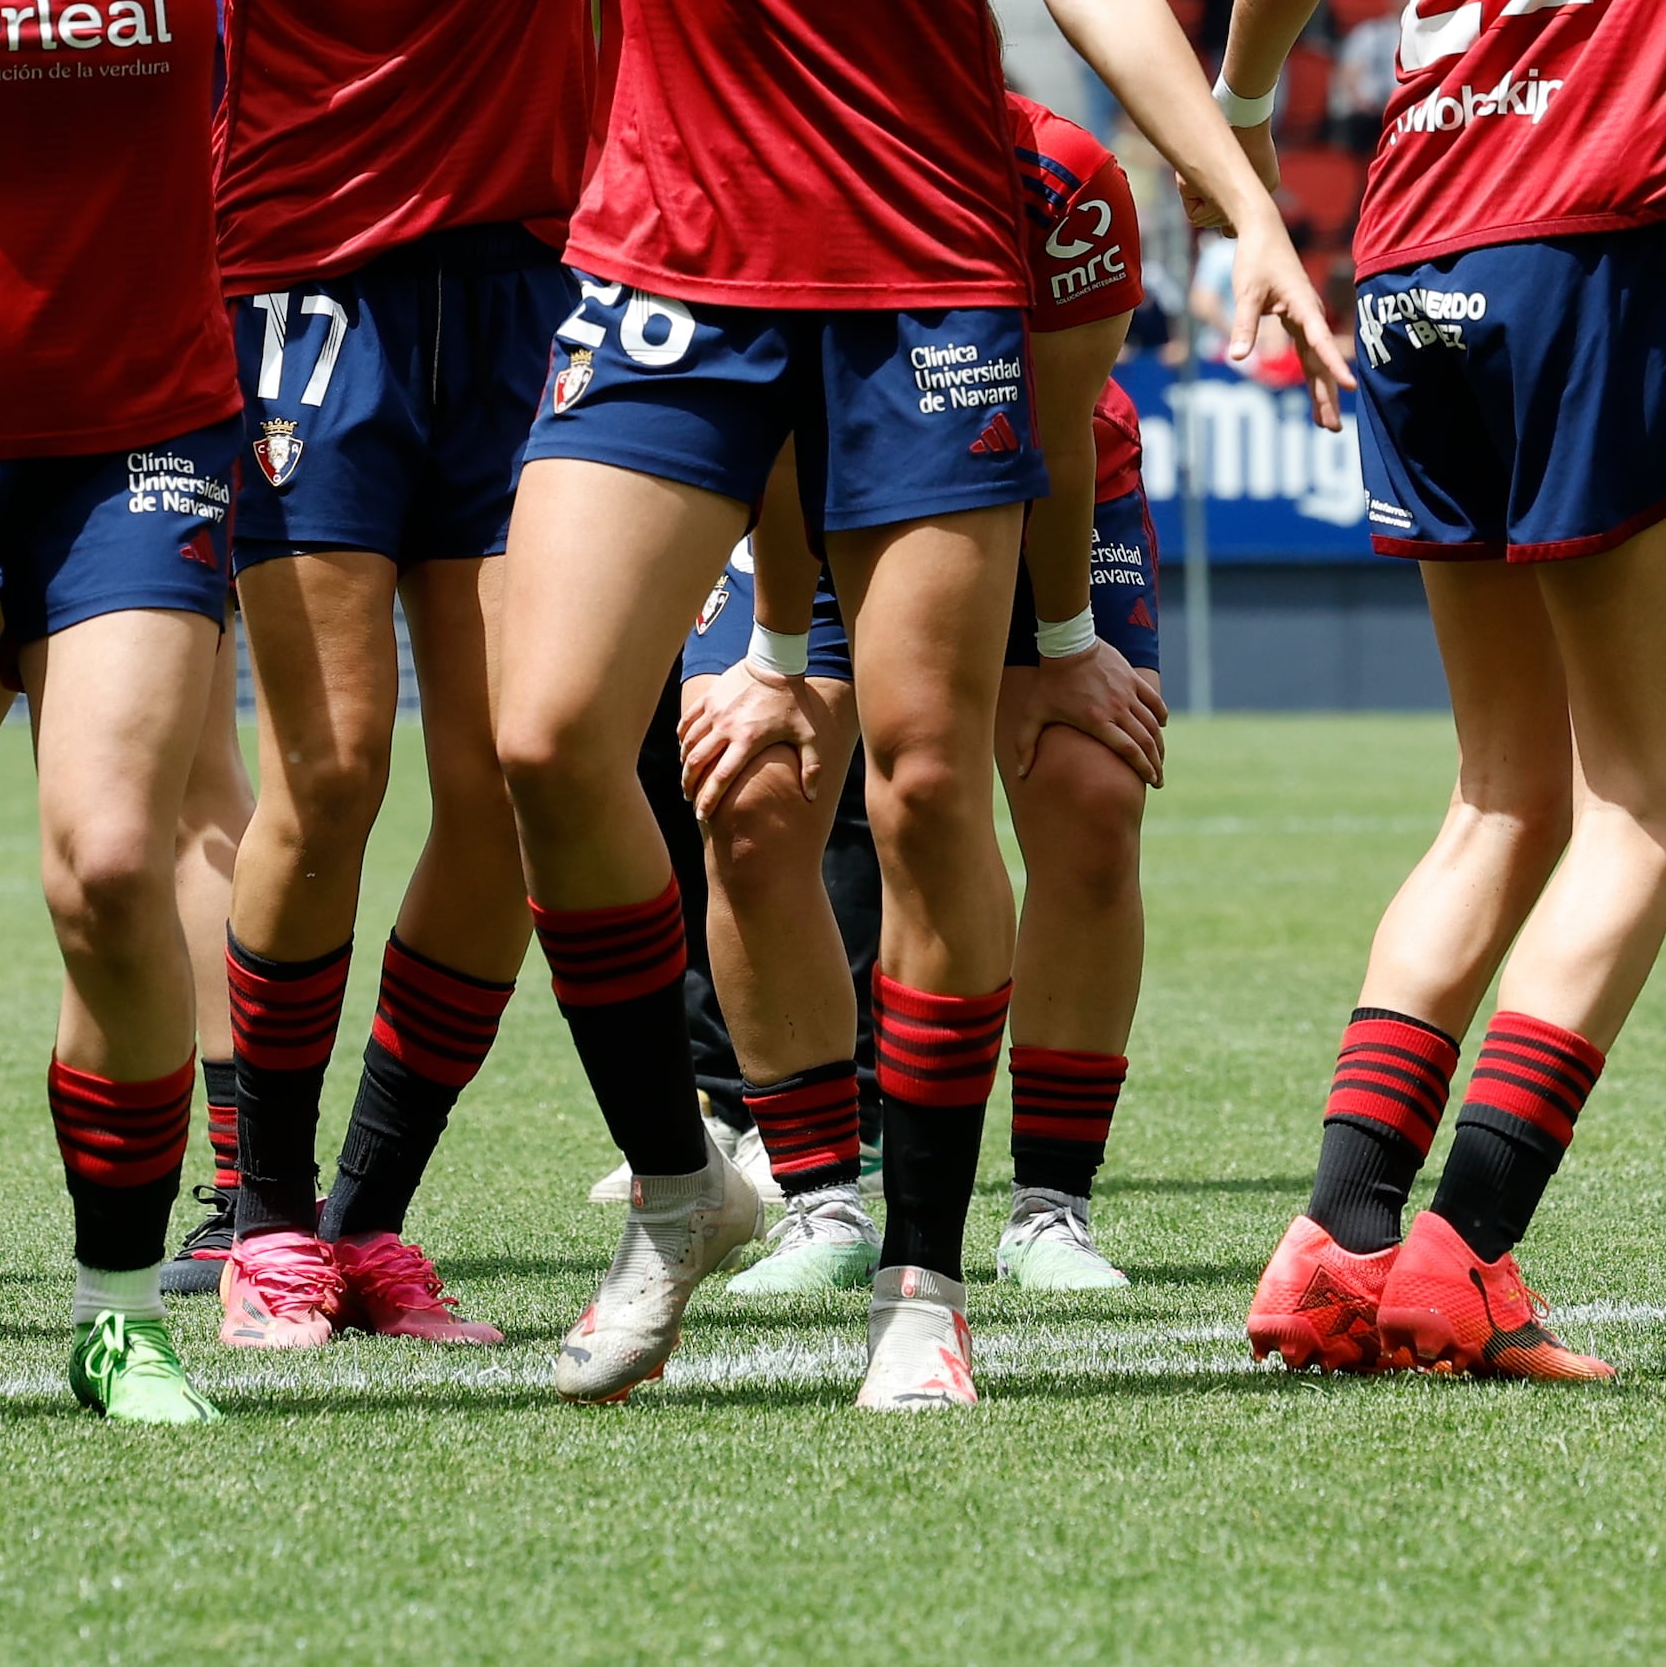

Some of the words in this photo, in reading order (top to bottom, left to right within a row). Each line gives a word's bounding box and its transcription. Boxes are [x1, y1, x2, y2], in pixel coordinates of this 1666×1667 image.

[48, 61, 72, 79] de
[77, 61, 93, 78] la
[99, 59, 171, 76] verdura
[1050, 244, 1125, 299] mrc
[1055, 286, 1092, 306] SOLUCIONES
[252, 292, 349, 407] 17
[911, 343, 978, 369] Clínica
[915, 357, 1021, 391] Universidad
[919, 392, 946, 414] de
[949, 385, 1018, 409] Navarra
[127, 451, 195, 474] Clínica
[128, 471, 230, 504] Universidad
[128, 492, 157, 514] de
[1089, 543, 1143, 566] ersidad
